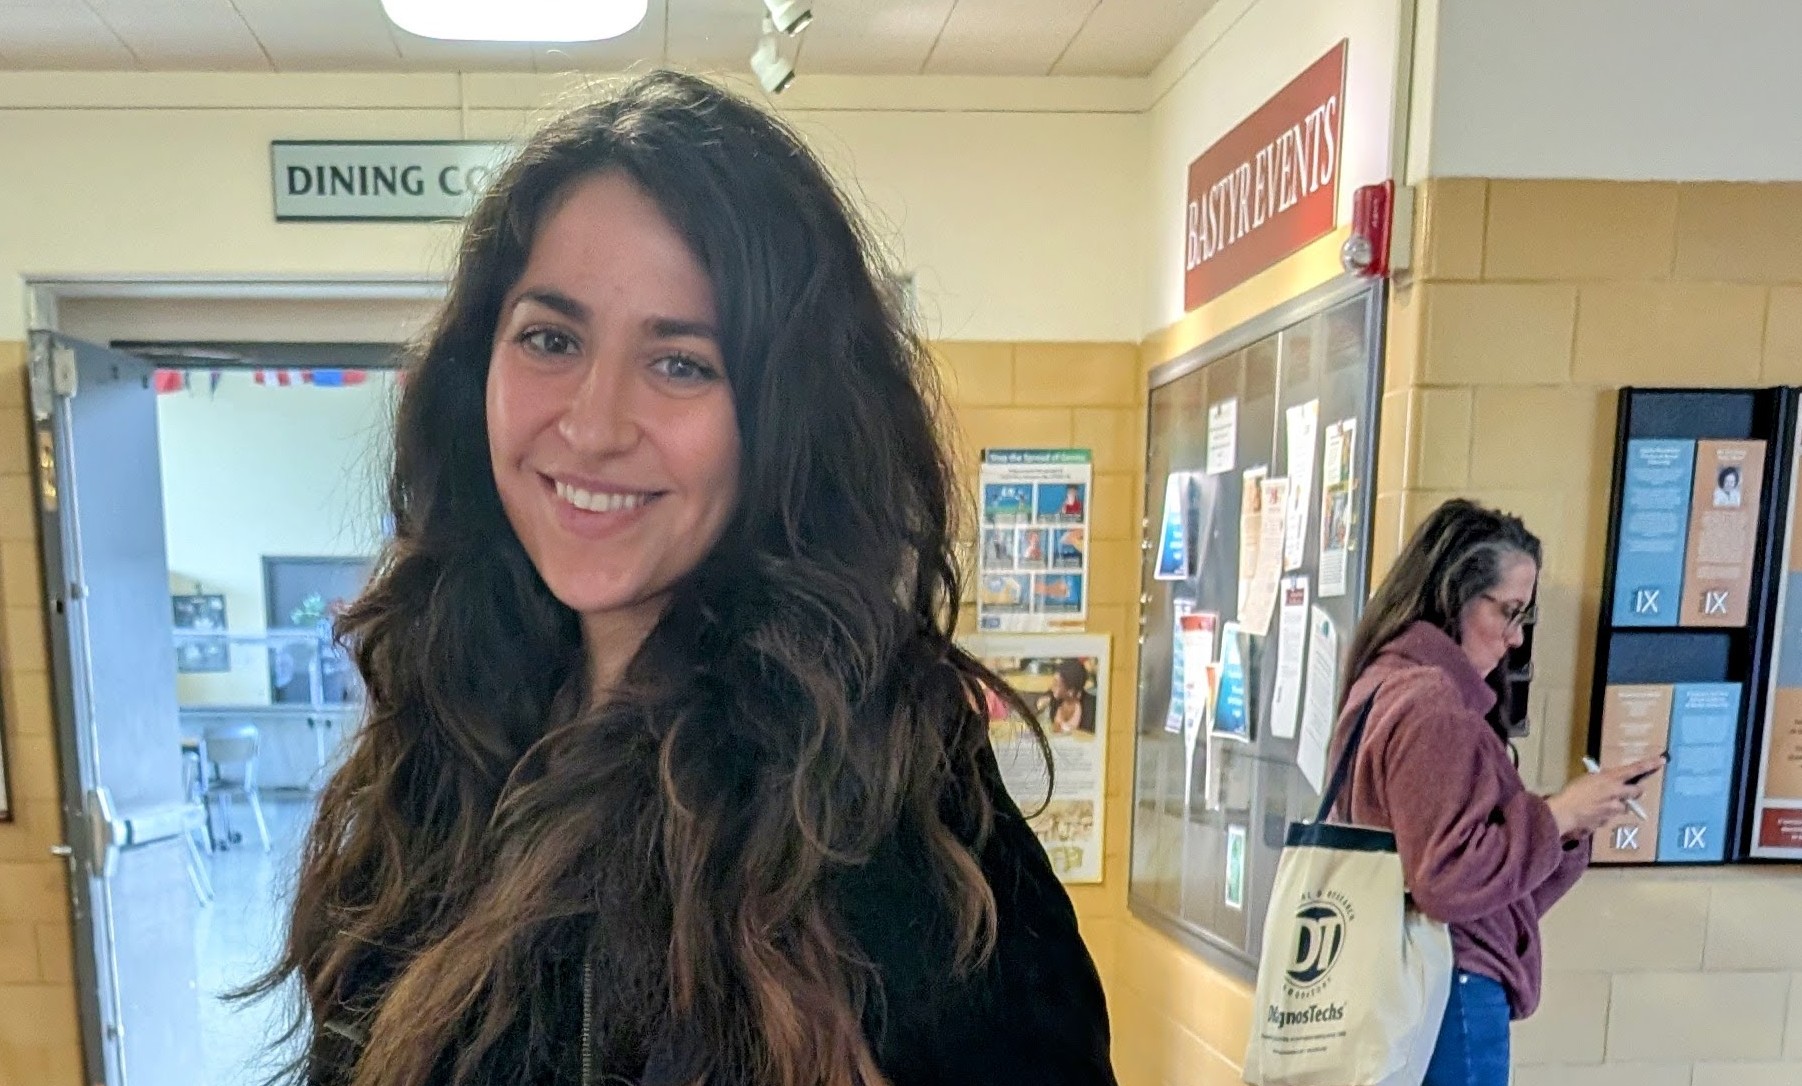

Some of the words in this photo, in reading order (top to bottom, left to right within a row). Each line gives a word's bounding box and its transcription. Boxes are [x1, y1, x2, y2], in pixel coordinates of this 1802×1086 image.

[287, 166, 424, 196] DINING
[1187, 162, 1250, 271] BASTYR
[1252, 96, 1336, 227] EVENTS
